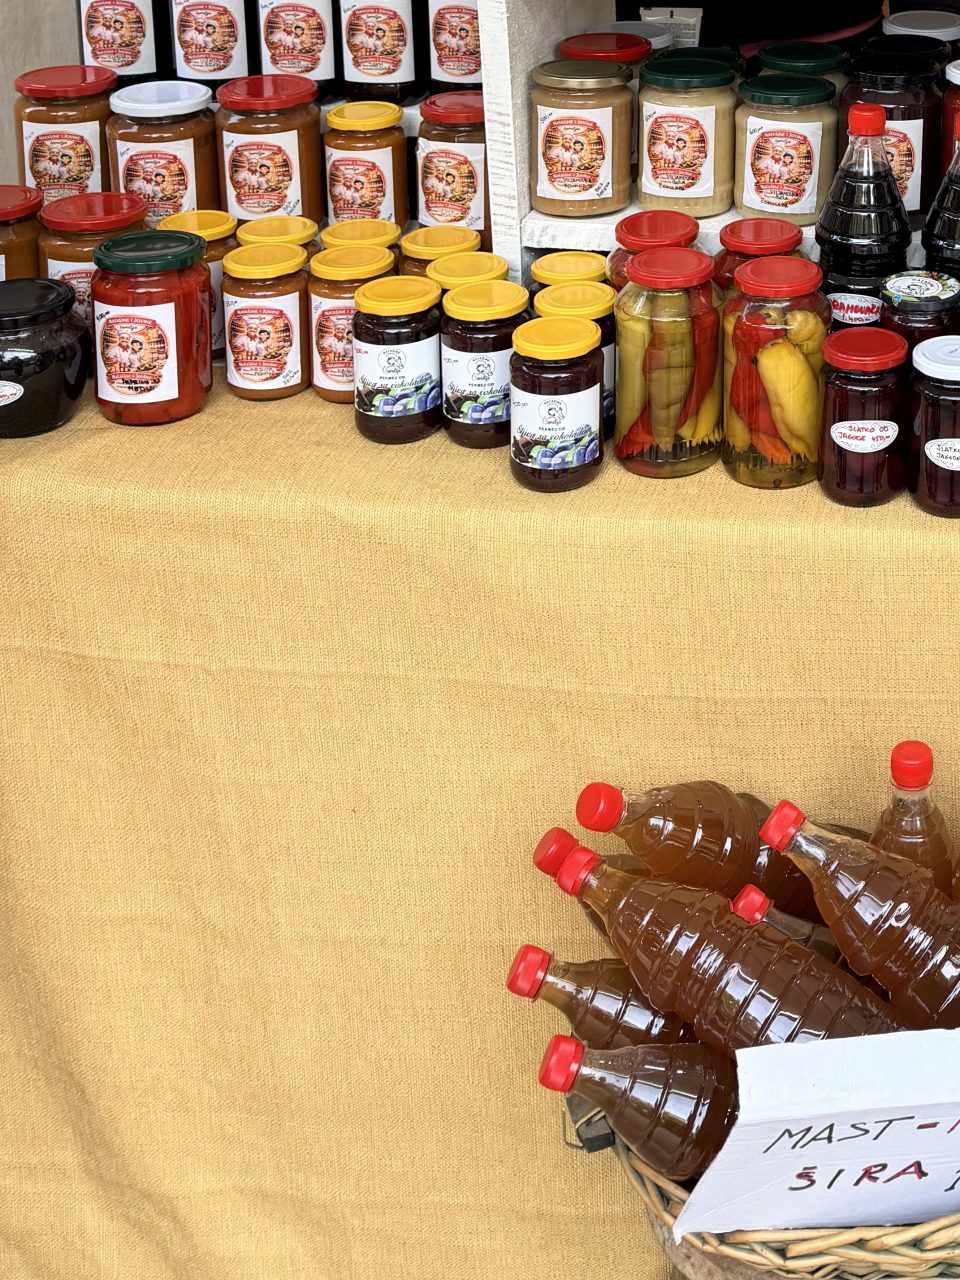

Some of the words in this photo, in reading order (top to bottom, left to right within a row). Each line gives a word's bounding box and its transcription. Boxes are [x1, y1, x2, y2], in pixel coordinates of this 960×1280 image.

[848, 425, 874, 433] SLATKO
[879, 425, 889, 433] OD
[763, 1116, 915, 1153] MAST
